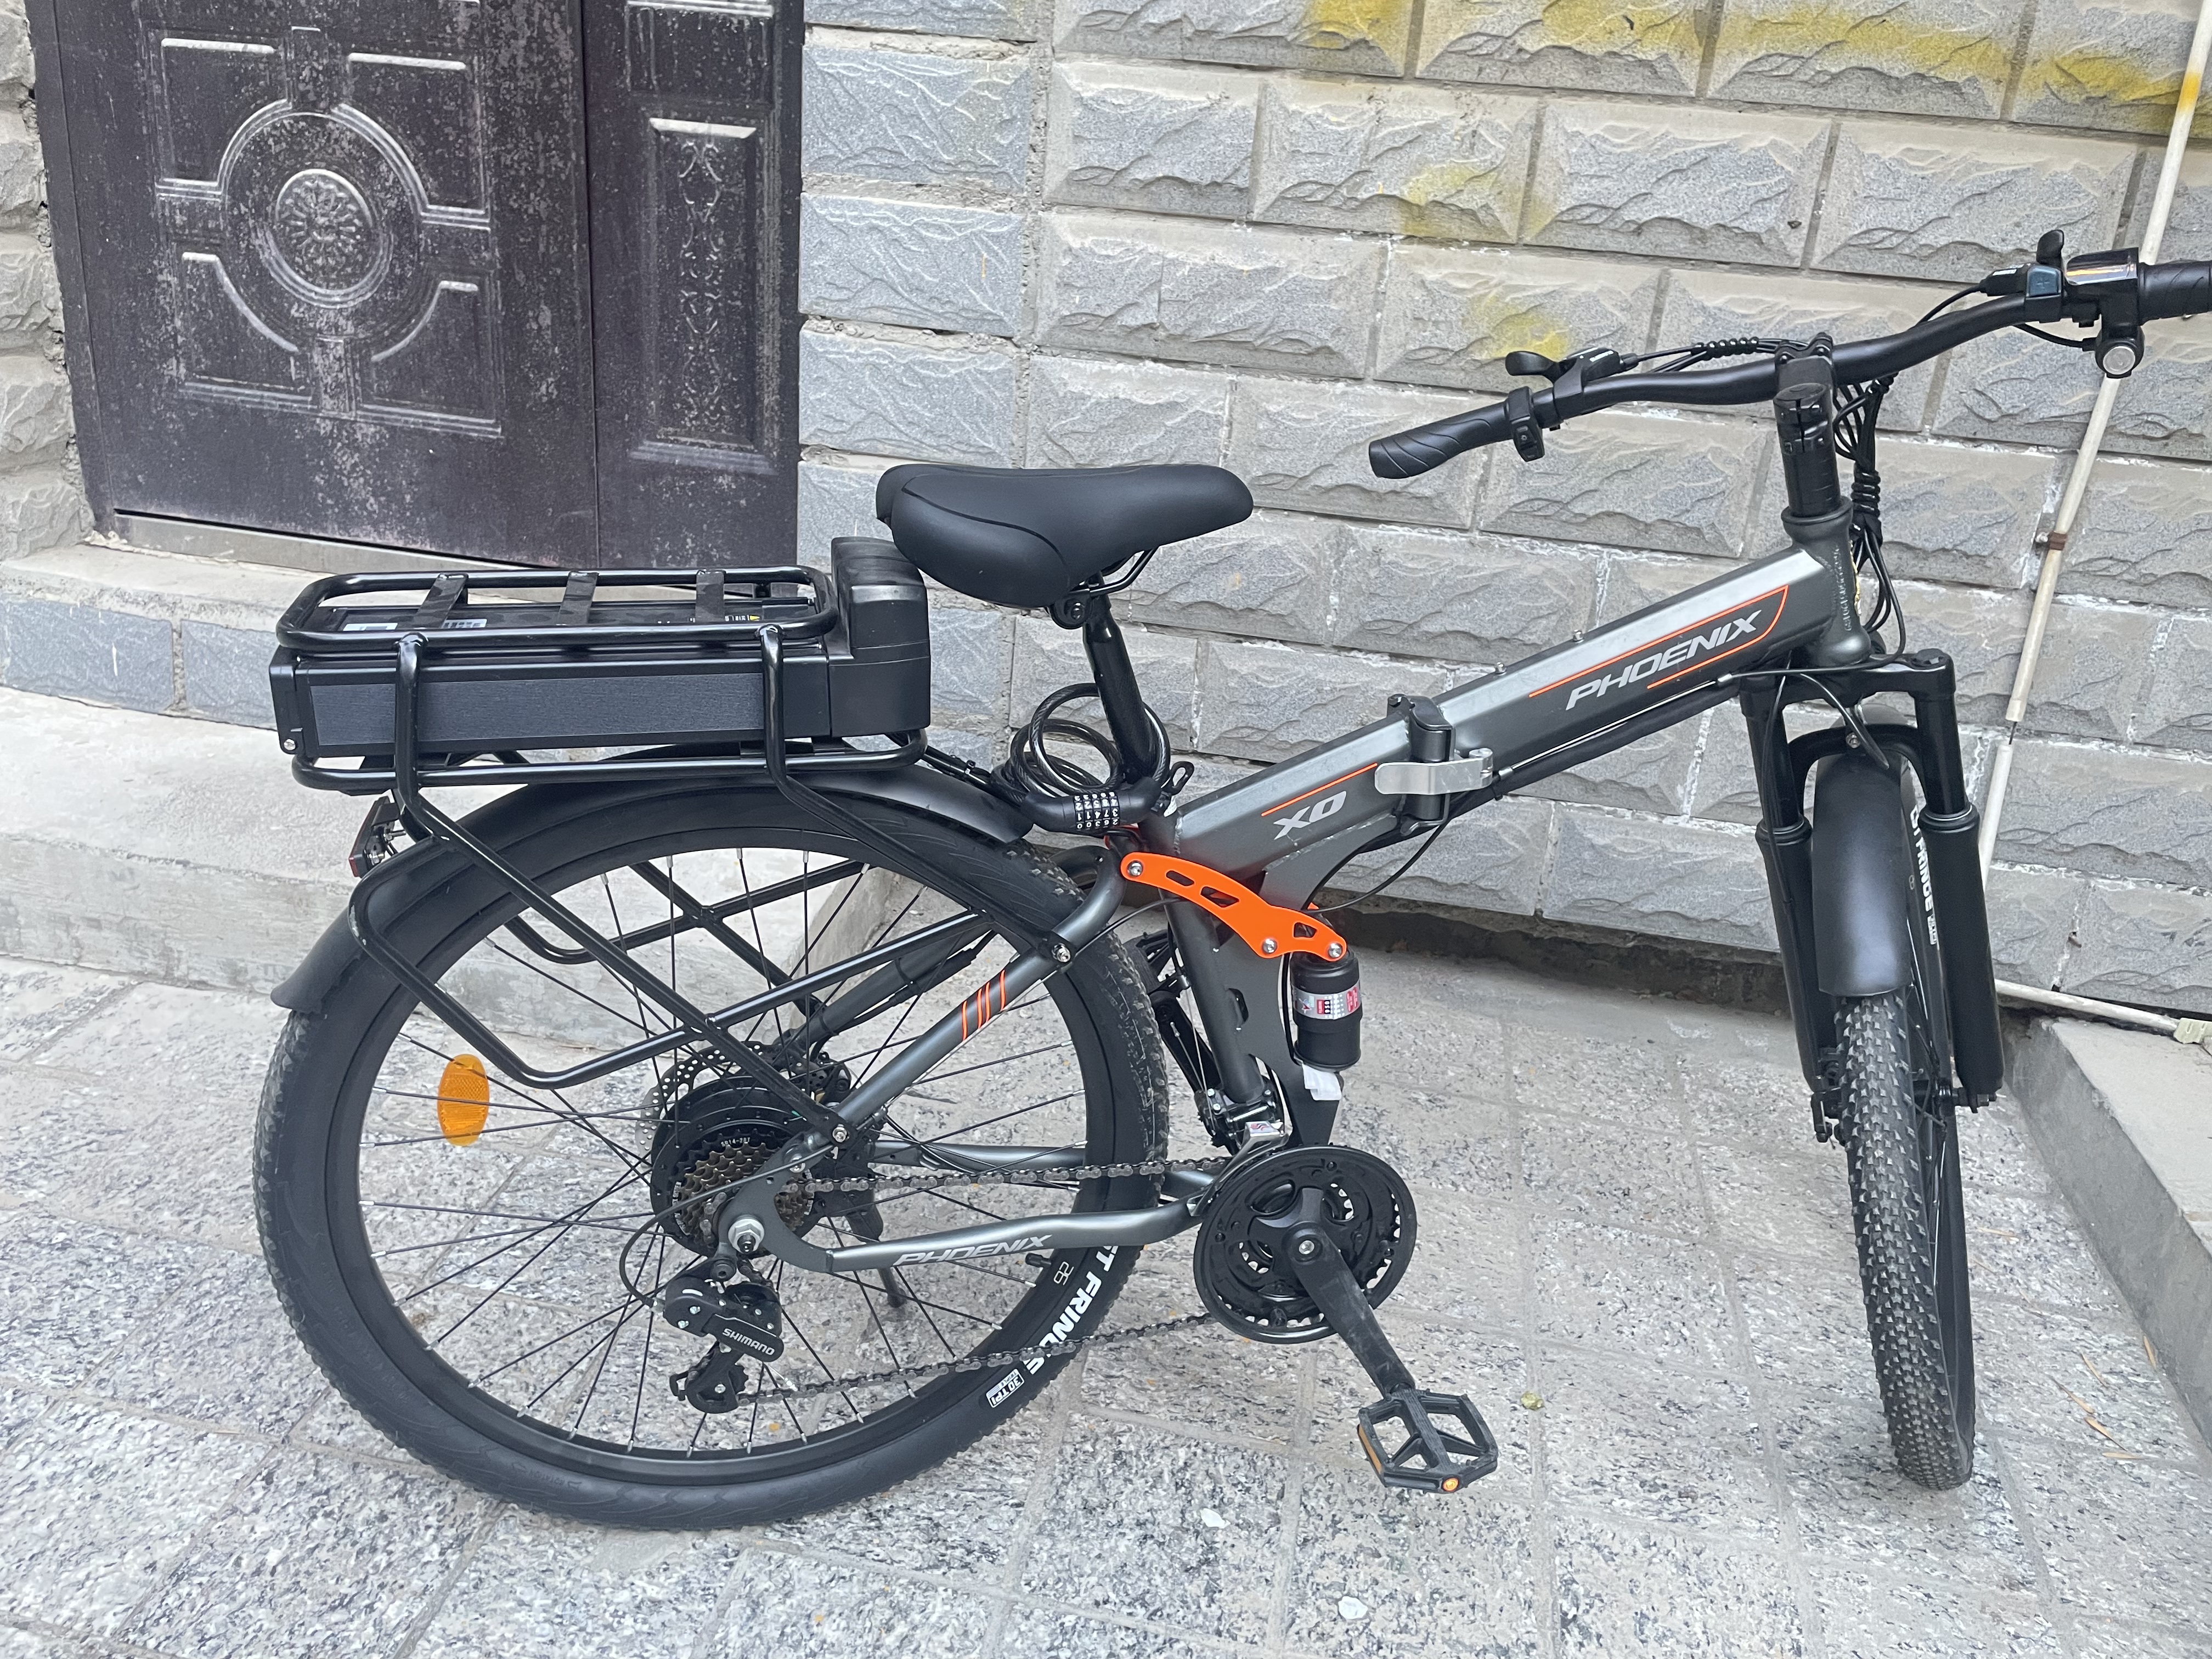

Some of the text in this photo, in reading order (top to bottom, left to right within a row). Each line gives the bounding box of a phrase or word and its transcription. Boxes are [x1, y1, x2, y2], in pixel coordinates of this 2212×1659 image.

[1565, 610, 1762, 710] PHOENIX
[893, 1234, 1052, 1266] PHOENIX
[722, 1328, 776, 1356] SHIMANO
[991, 1376, 1021, 1405] 30 TPI
